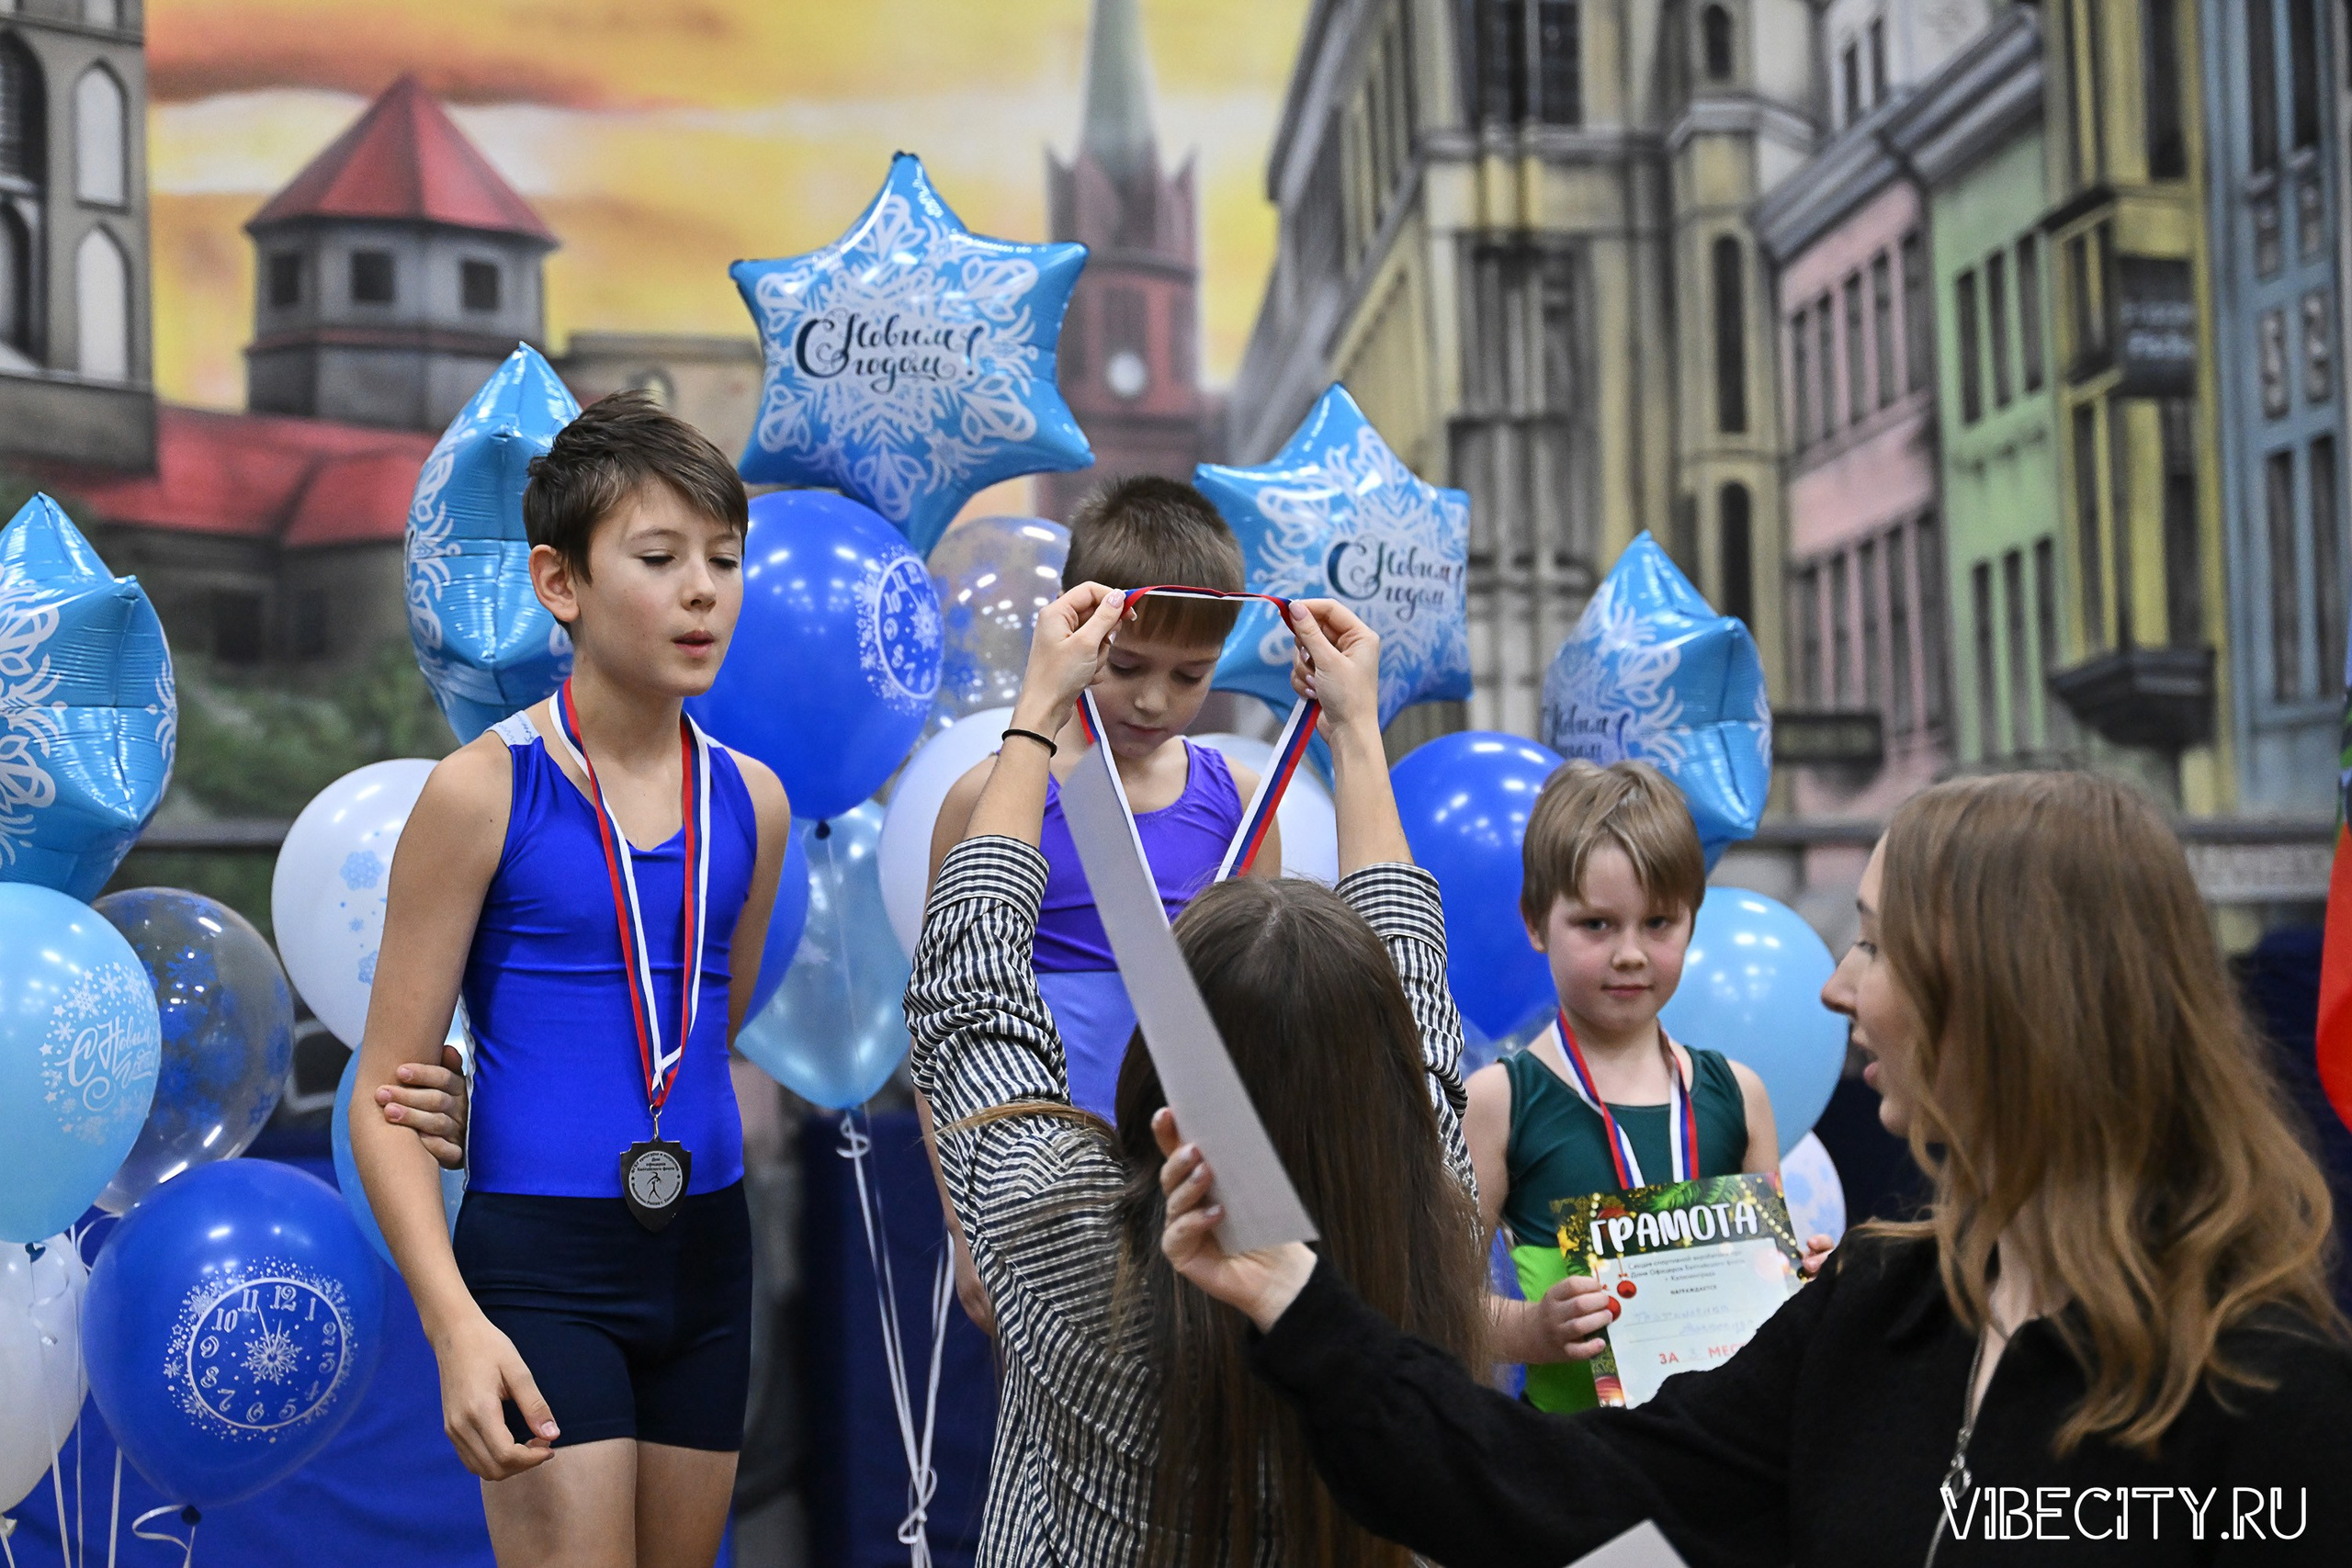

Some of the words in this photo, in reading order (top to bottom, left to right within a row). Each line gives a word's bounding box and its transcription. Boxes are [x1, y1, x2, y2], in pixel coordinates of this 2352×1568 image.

[842, 312, 963, 353] Новым
[883, 589, 902, 615] 10
[883, 617, 899, 641] 9
[891, 644, 905, 669] 8
[903, 661, 917, 688] 7
[1589, 1201, 1758, 1256] ГРАМОТА
[237, 1288, 259, 1314] 11
[269, 1284, 297, 1312] 12
[304, 1297, 316, 1321] 1
[211, 1307, 238, 1333] 10
[322, 1321, 337, 1346] 2
[199, 1335, 220, 1359] 9
[1658, 1352, 1679, 1365] ЗА
[318, 1351, 335, 1374] 3
[199, 1366, 220, 1389] 8
[217, 1388, 236, 1412] 7
[246, 1401, 265, 1423] 6
[278, 1397, 298, 1420] 5
